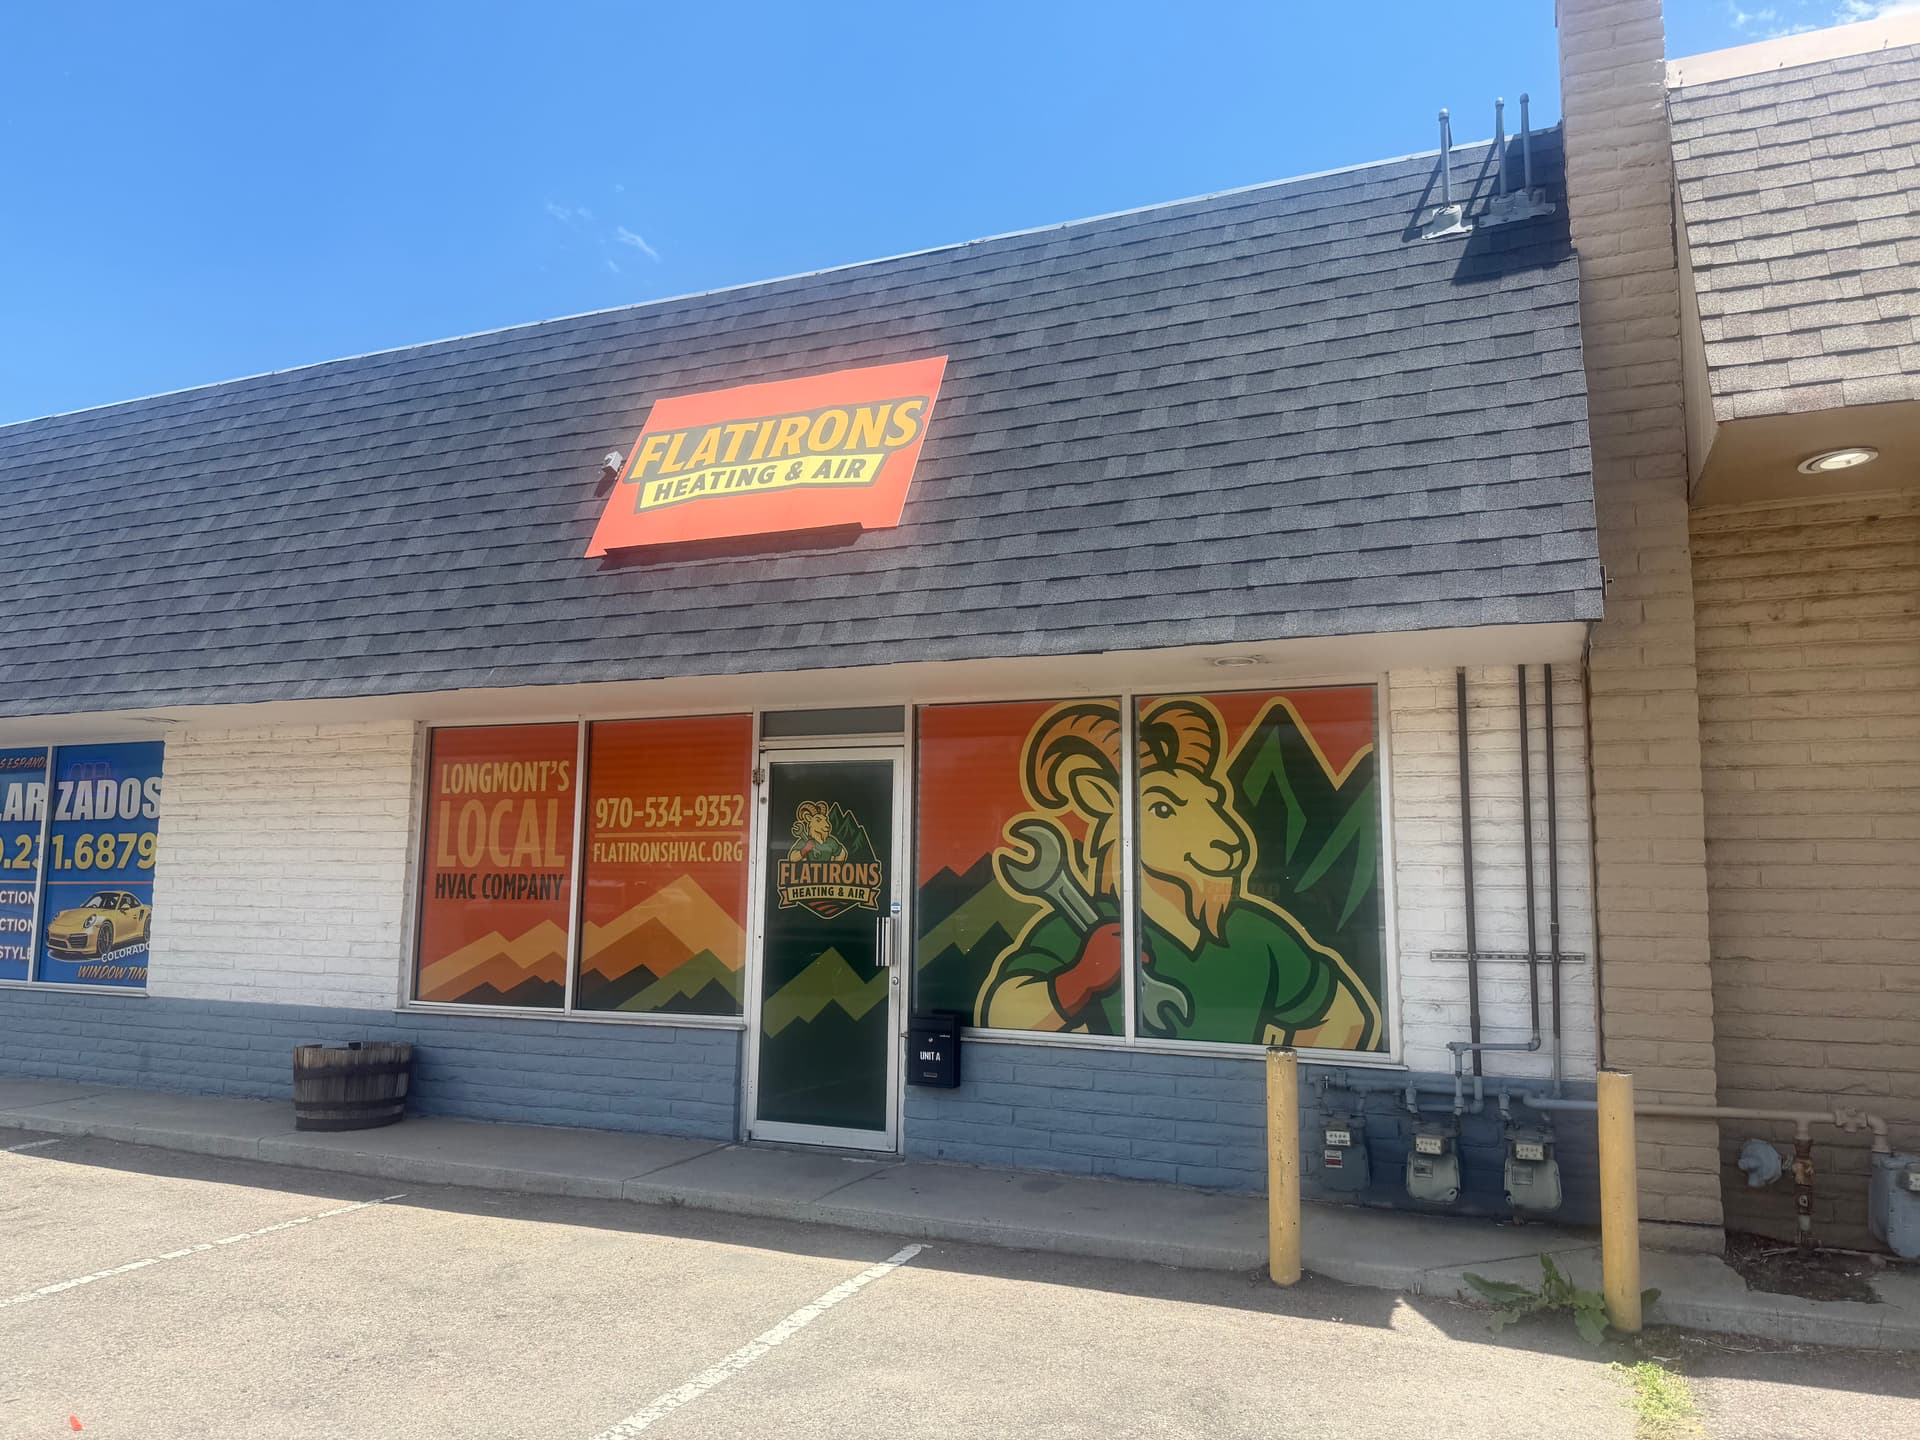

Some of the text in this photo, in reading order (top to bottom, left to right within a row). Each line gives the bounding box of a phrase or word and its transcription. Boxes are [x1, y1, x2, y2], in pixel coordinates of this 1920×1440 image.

[627, 399, 926, 481] FLATIRONS
[653, 459, 868, 503] HEATING & AIR
[441, 760, 570, 794] LONGMONT'S
[595, 794, 745, 829] 970-534-9352
[436, 798, 566, 868] LOCAL
[593, 841, 743, 863] FLATIRONSHVAC.ORG
[434, 873, 565, 900] HVAC COMPANY
[780, 863, 880, 886] FLATIRONS
[792, 886, 865, 899] HEATING & AIR
[101, 942, 151, 962] COLORADO
[77, 965, 127, 980] WINDOW
[920, 1051, 941, 1061] UNIT A
